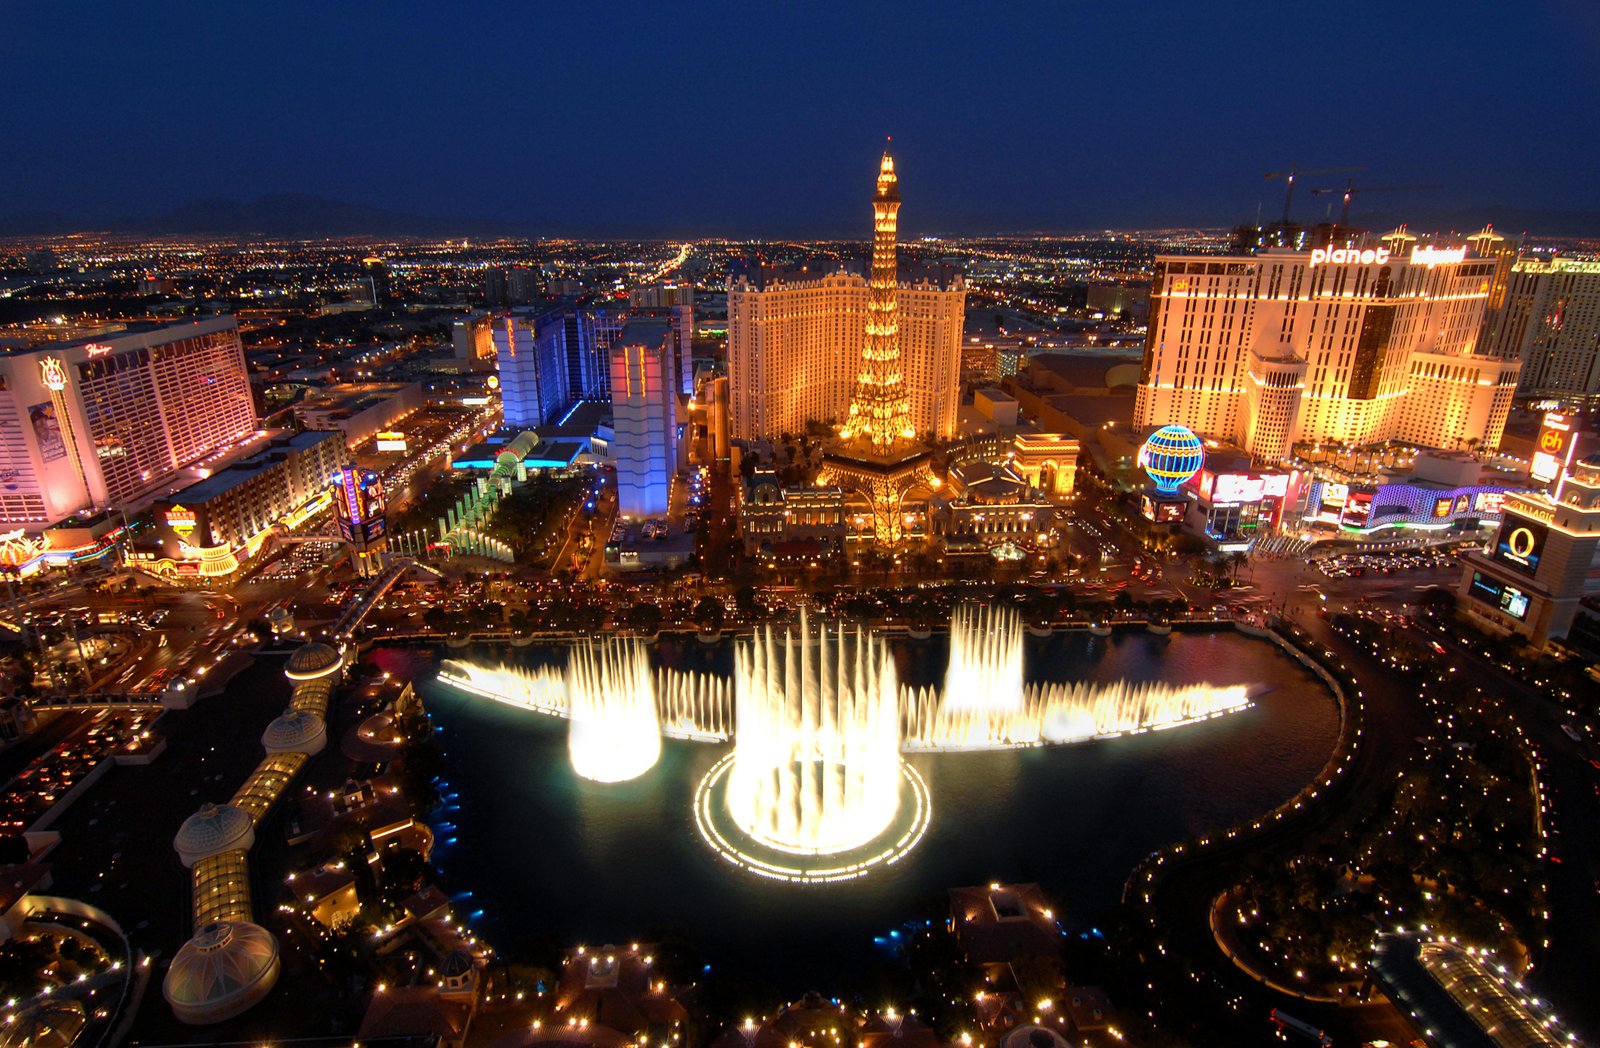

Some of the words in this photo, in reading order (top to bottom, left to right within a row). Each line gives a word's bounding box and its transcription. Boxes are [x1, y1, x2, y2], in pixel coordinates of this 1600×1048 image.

[1309, 244, 1391, 268] planet
[1410, 244, 1467, 269] hollywood
[1541, 432, 1563, 449] ph
[1509, 527, 1535, 558] O
